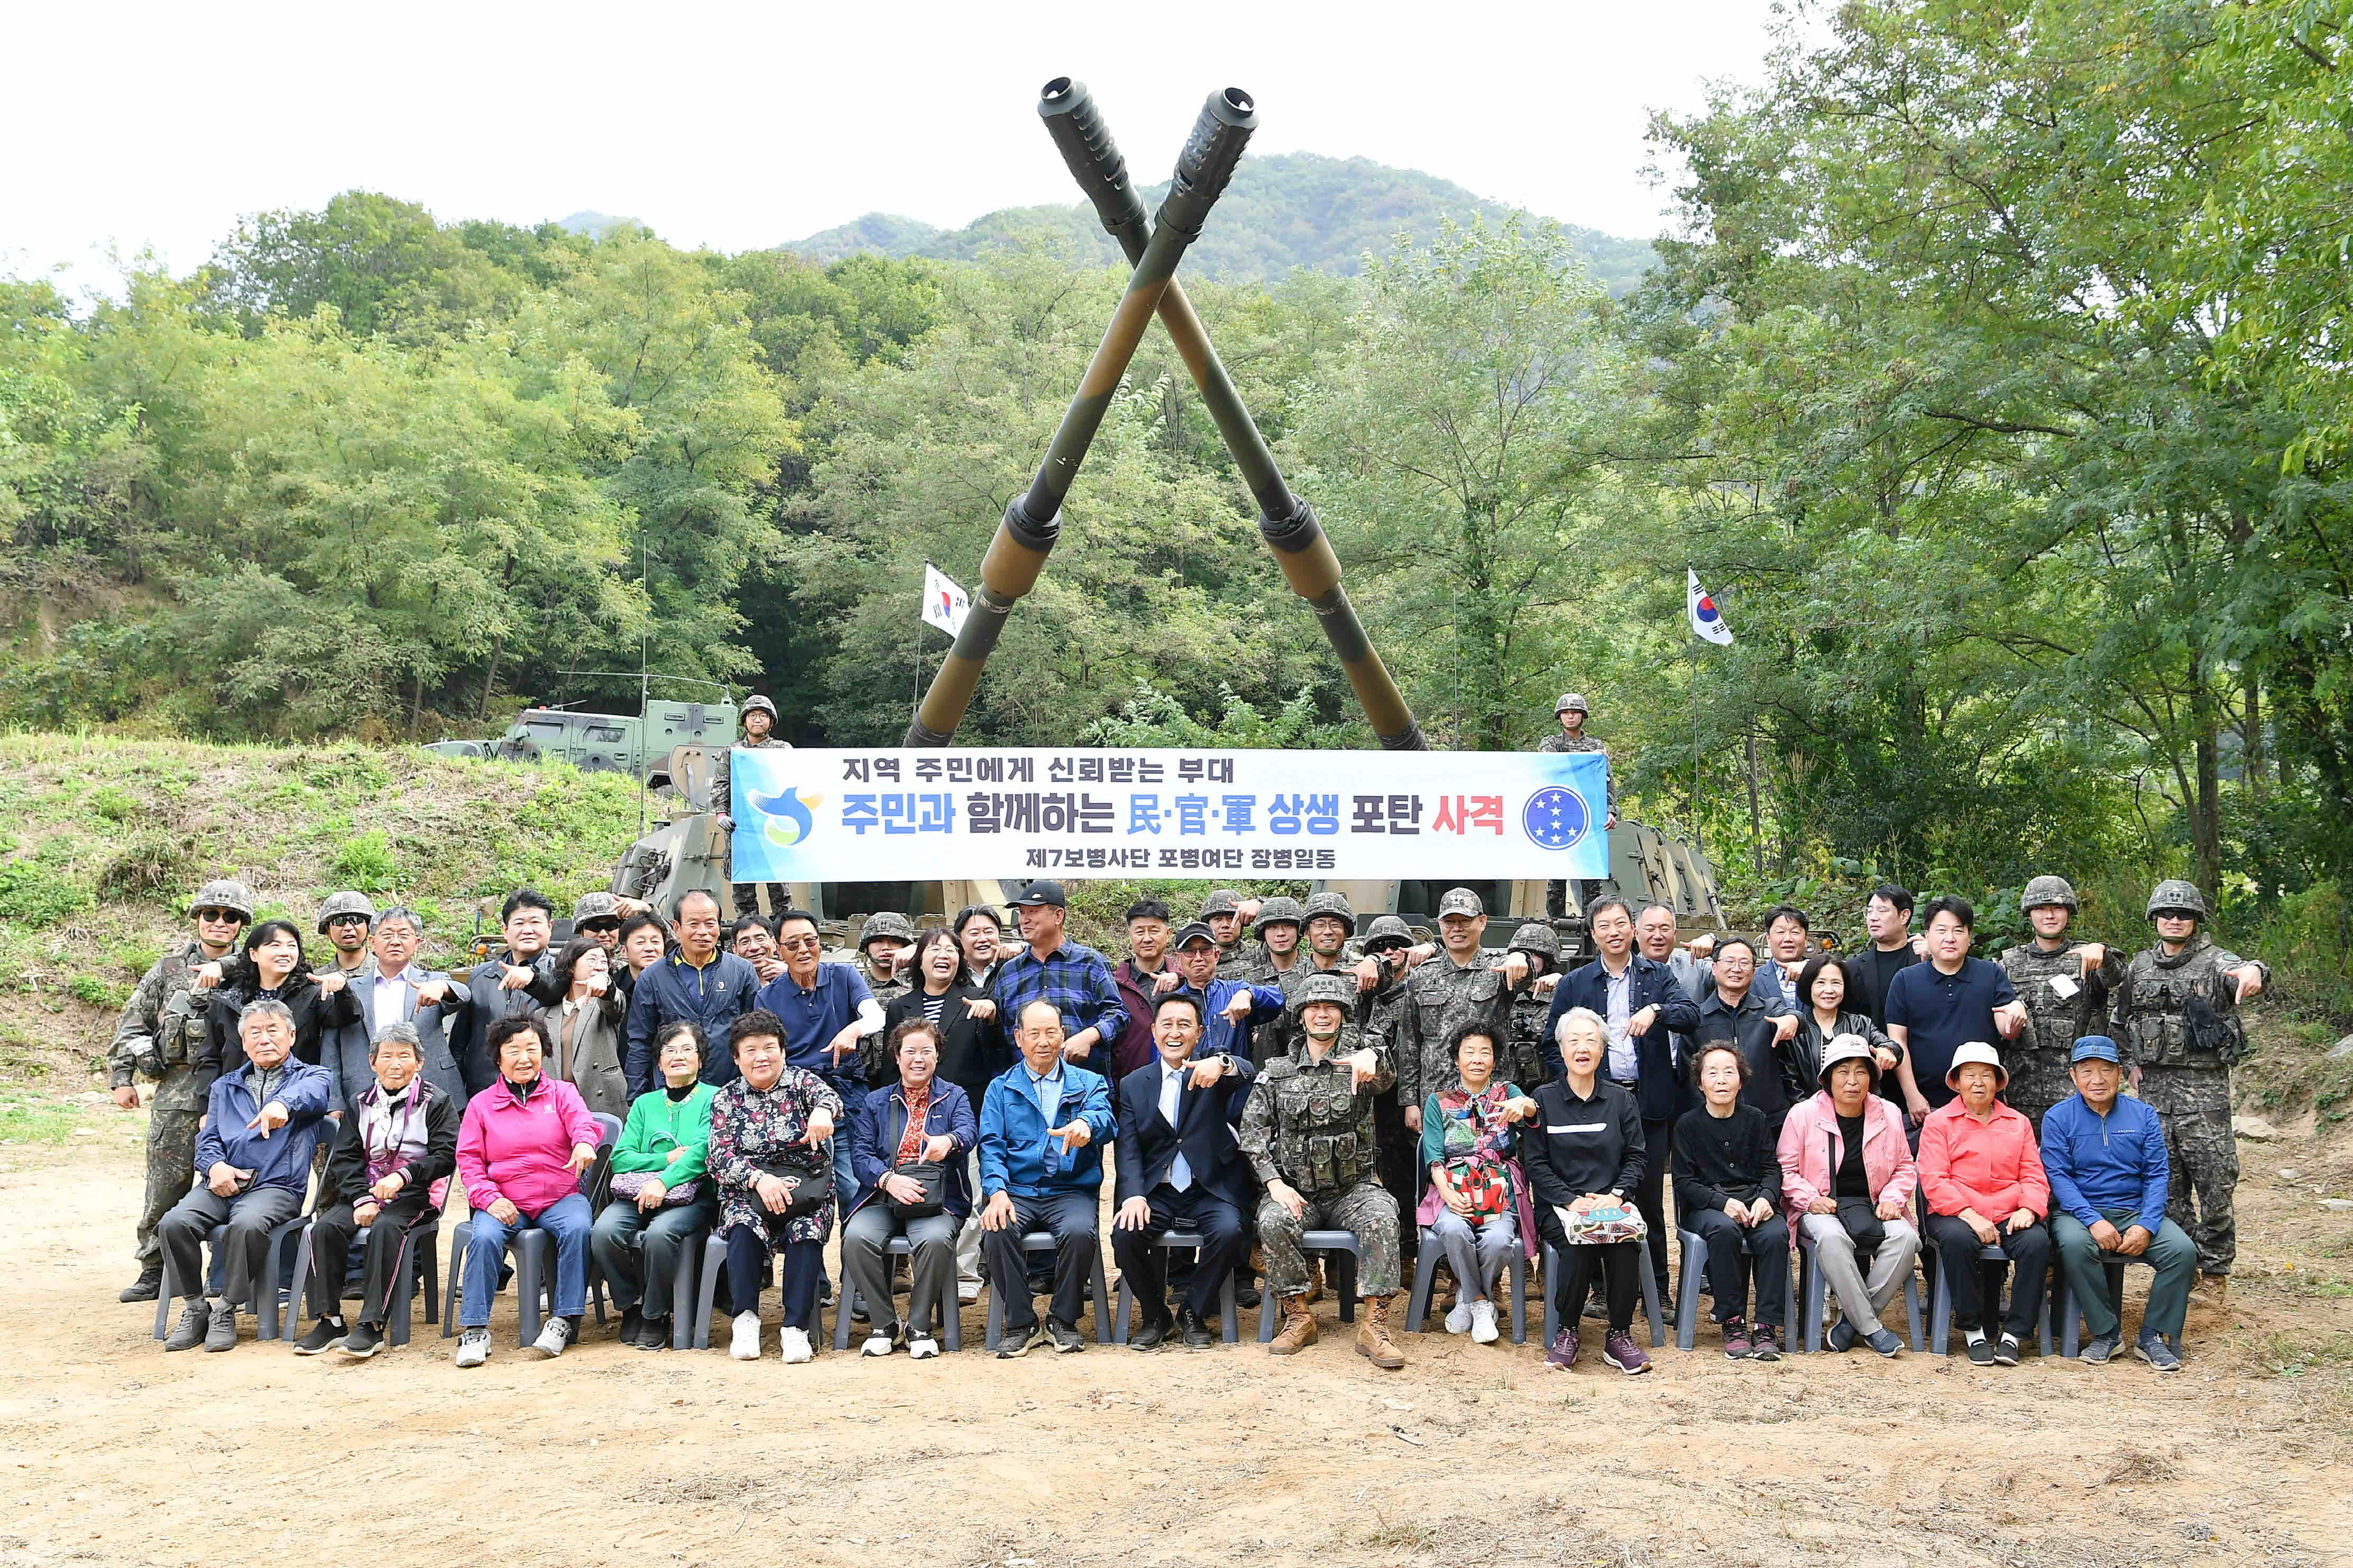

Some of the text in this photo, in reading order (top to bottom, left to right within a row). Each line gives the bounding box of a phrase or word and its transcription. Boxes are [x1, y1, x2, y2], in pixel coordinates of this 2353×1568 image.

[843, 758, 1233, 783] 지역 주민에게 신뢰받는 부대
[842, 794, 956, 834] 주민과
[967, 792, 1114, 833] 함께하는
[1268, 794, 1339, 835] 상생
[1352, 795, 1423, 834] 포탄
[1432, 795, 1503, 835] 사격
[1026, 848, 1335, 869] 제7보병사단 포병여단 장병일동
